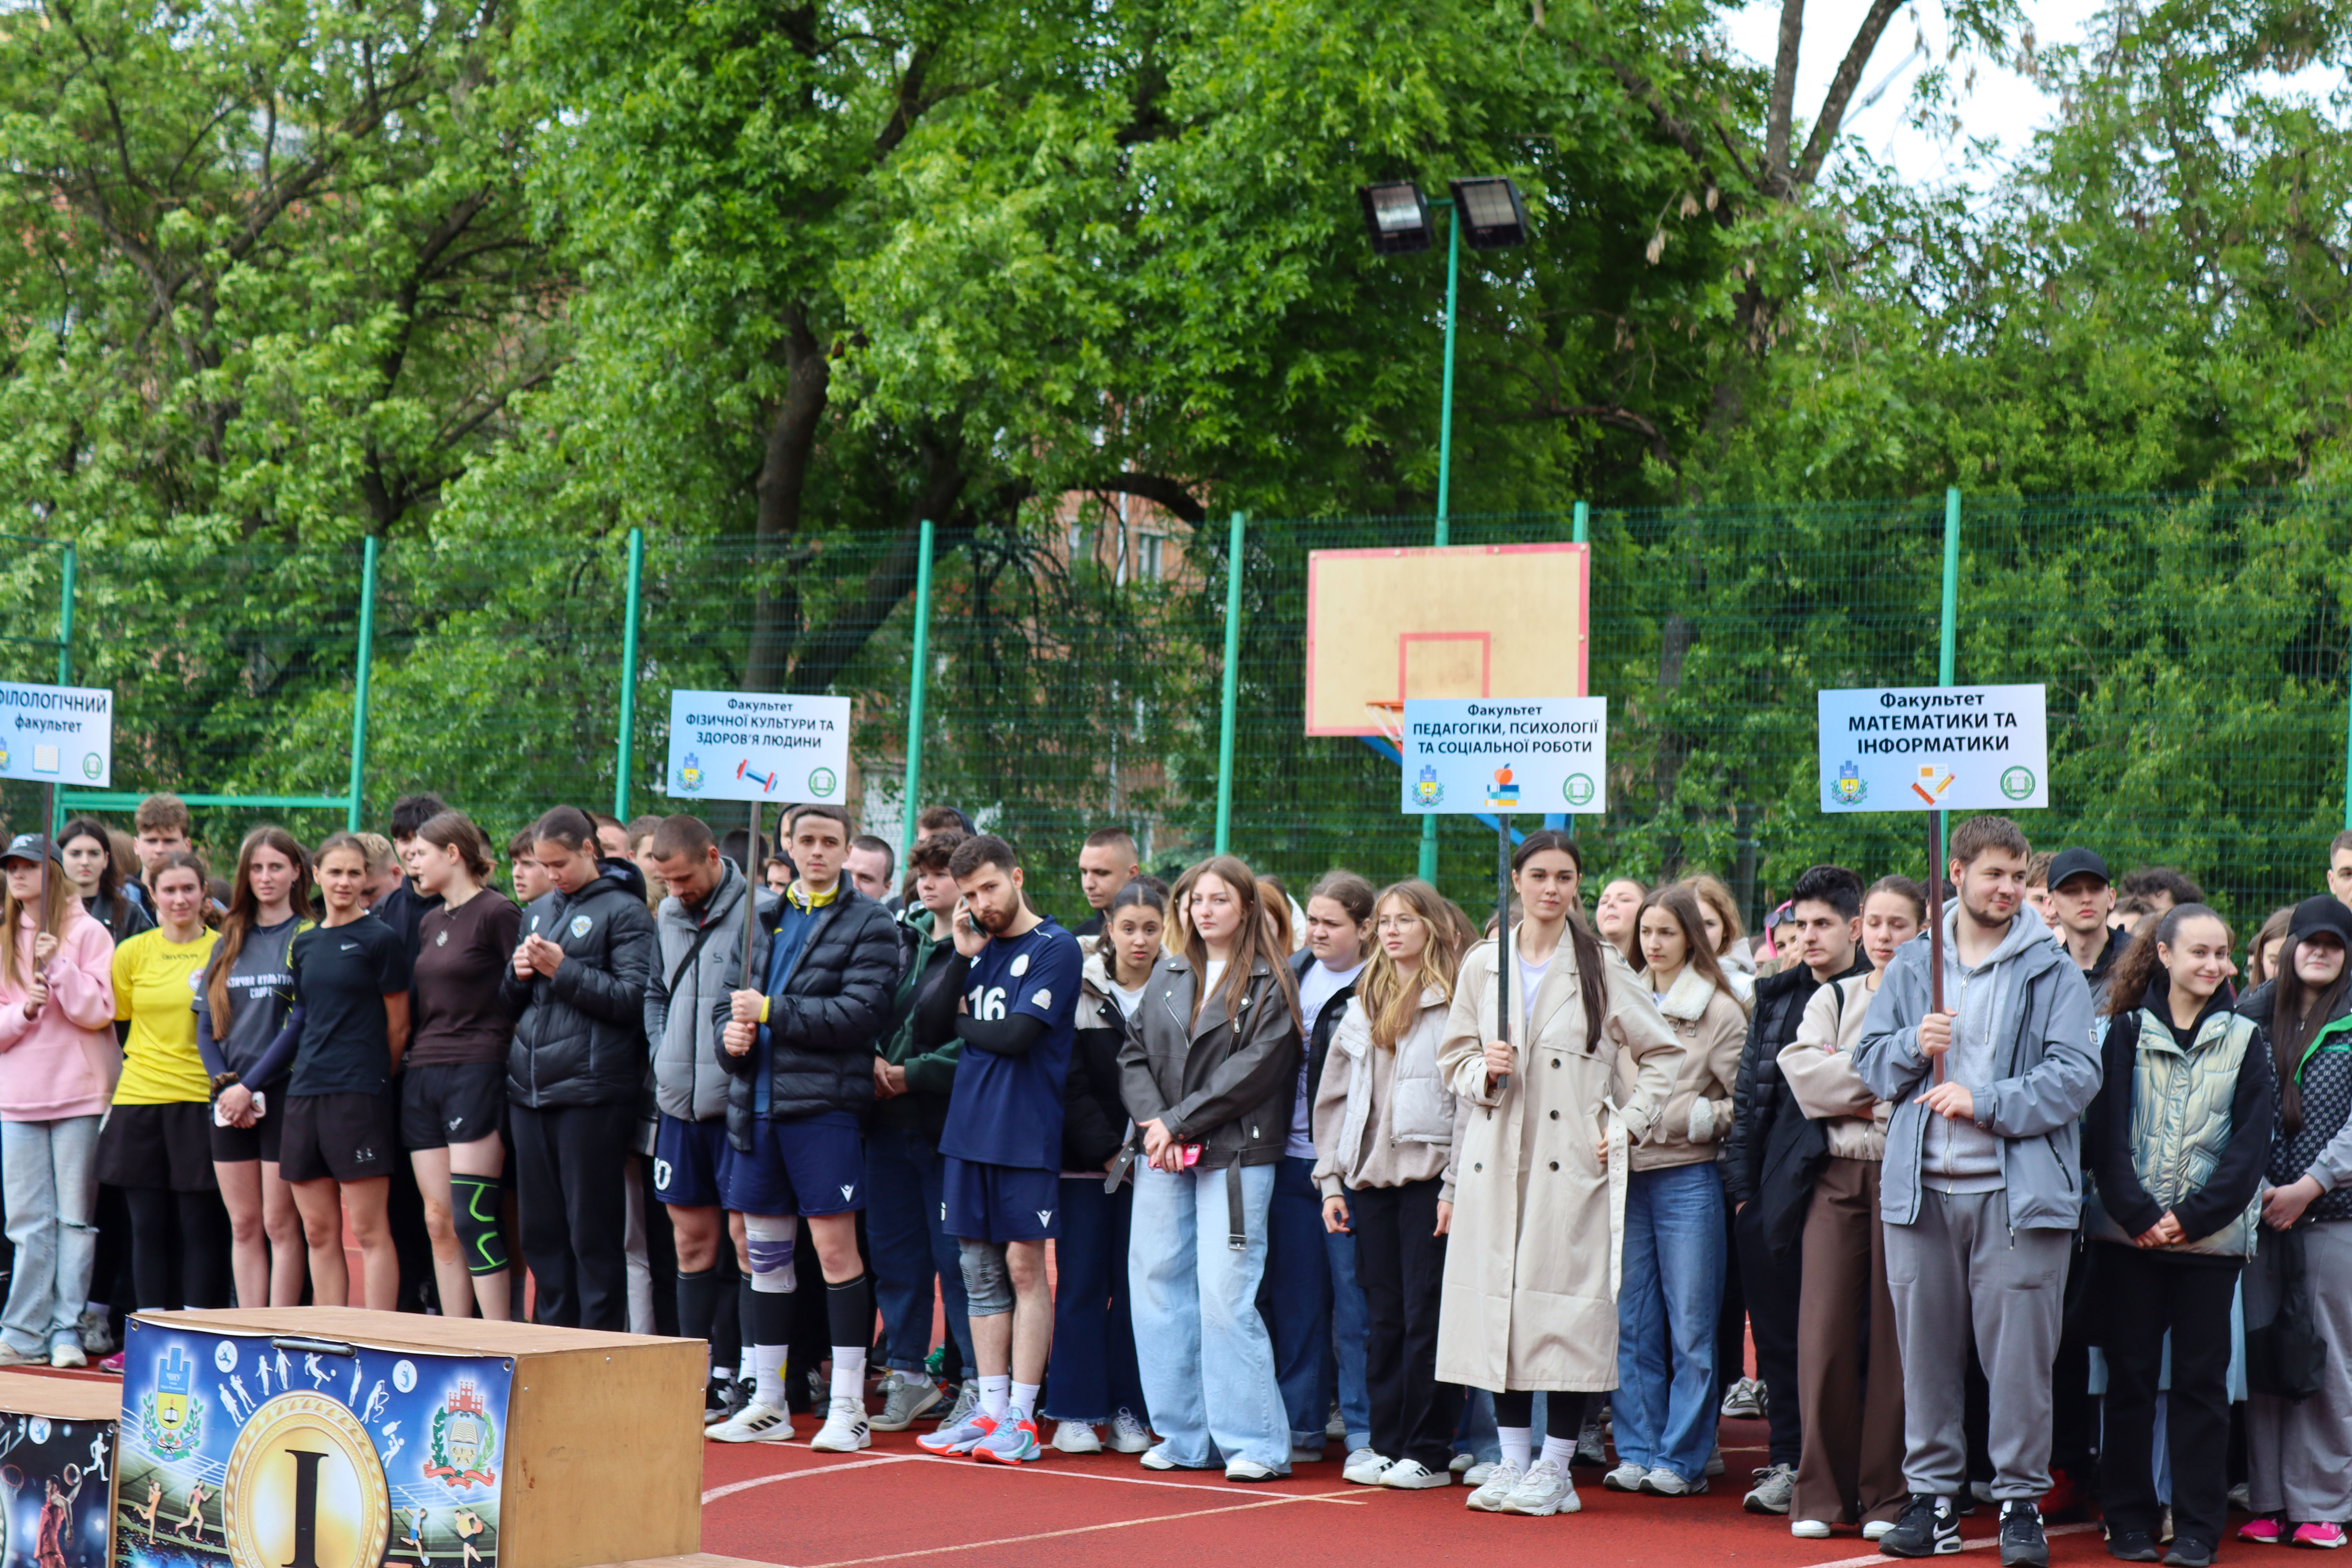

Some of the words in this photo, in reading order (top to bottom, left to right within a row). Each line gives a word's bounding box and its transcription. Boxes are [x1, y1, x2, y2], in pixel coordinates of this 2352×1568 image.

[728, 698, 793, 712] Факультет
[1880, 693, 1985, 710] Факультет
[1468, 704, 1542, 718] Факультет
[15, 713, 82, 733] факультет
[686, 714, 748, 727] ФІЗИЧНОЇ
[751, 717, 815, 730] КУЛЬТУРИ
[820, 720, 834, 731] ТА
[1413, 723, 1506, 737] ПЕДАГОГІКИ,
[1510, 719, 1598, 734] ПСИХОЛОГІЇ
[1848, 713, 1988, 731] МАТЕМАТИКИ
[1993, 713, 2017, 728] ТА
[762, 735, 821, 748] ЛЮДИНИ
[1418, 742, 1434, 753] ТА
[1438, 739, 1529, 756] СОЦІАЛЬНОЇ
[1533, 742, 1592, 753] РОБОТИ
[1858, 736, 2009, 754] ІНФОРМАТИКИ
[969, 984, 1006, 1021] 16
